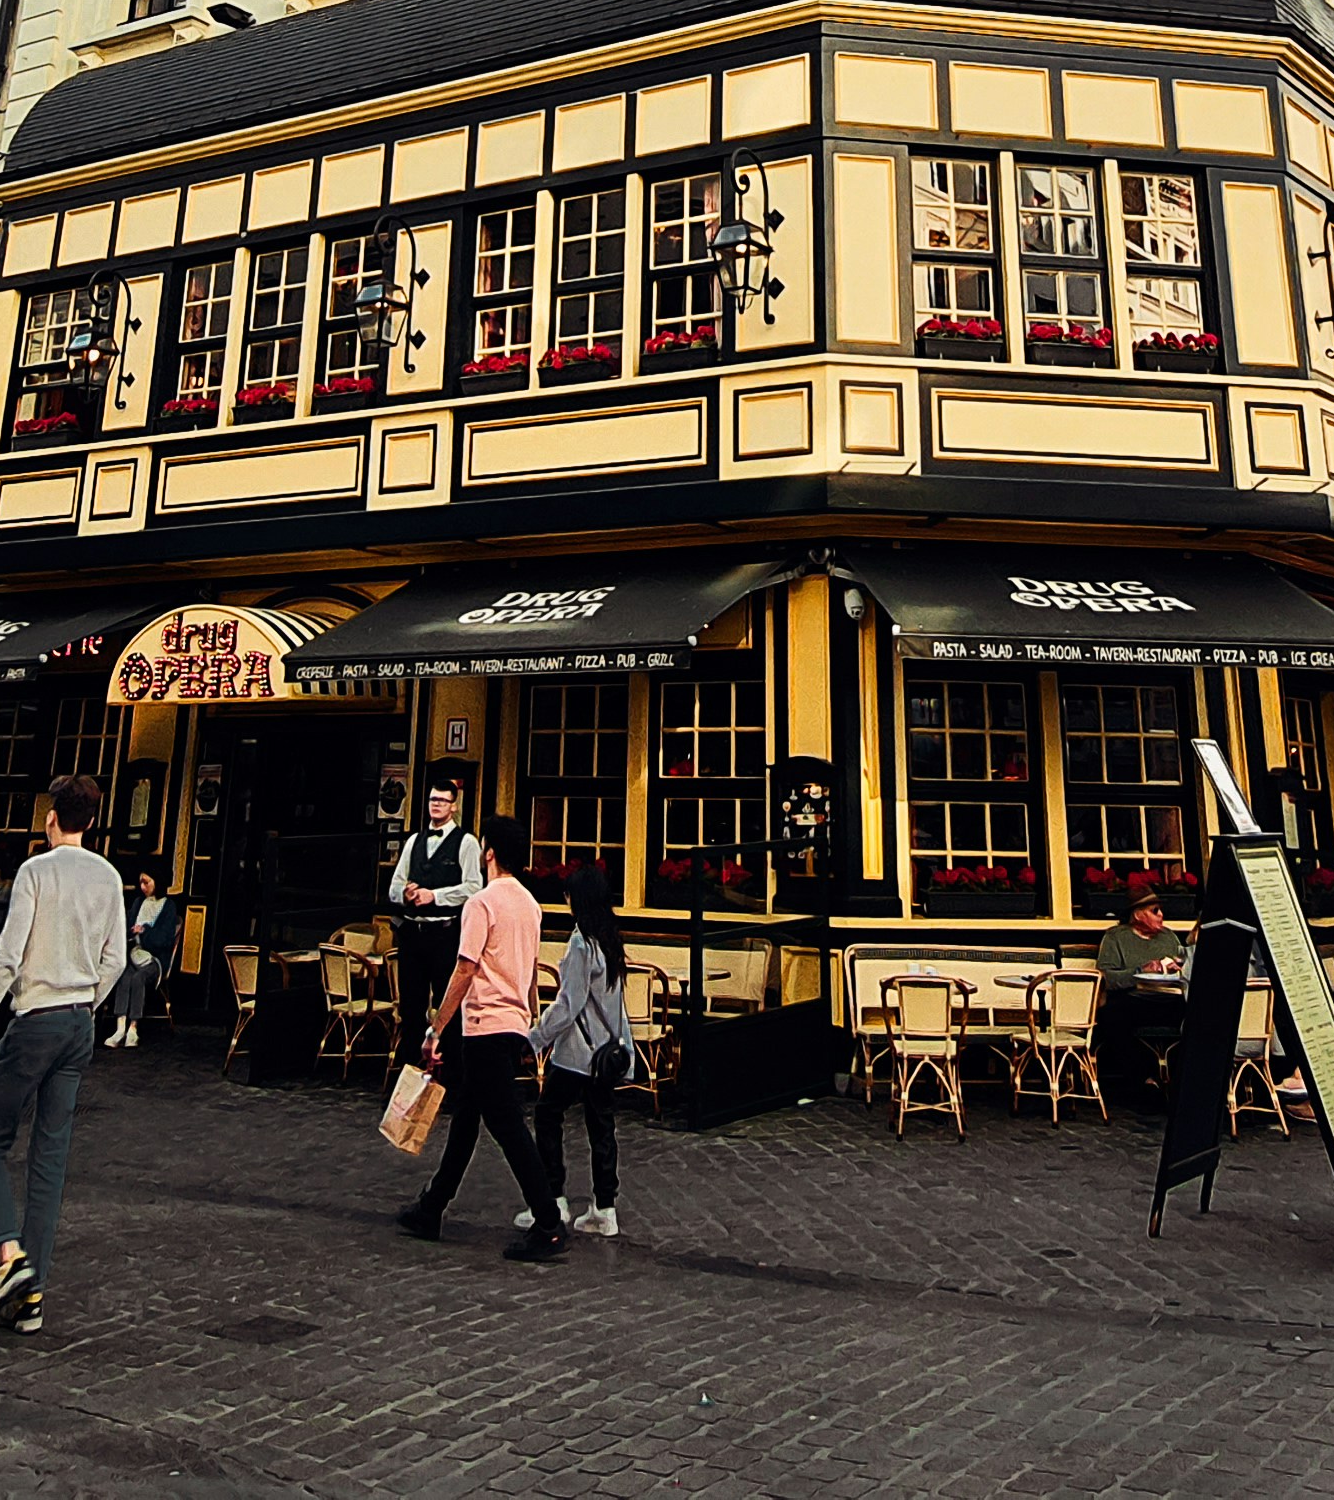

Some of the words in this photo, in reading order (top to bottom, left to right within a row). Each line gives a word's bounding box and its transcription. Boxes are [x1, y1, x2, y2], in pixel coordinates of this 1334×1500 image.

[492, 586, 616, 607] DRUG
[1007, 576, 1155, 596] DRUG
[458, 603, 604, 624] OPERA
[1010, 592, 1197, 613] OPERA
[161, 612, 240, 654] drug
[933, 642, 967, 657] PASTA
[979, 643, 1013, 659] SALAD
[1025, 644, 1082, 660] TEA-ROOM
[1093, 646, 1202, 663] TAVERN-RESTAURANT
[1213, 648, 1247, 664] PIZZA
[1258, 650, 1279, 665] PUB
[1290, 651, 1307, 666] ICE
[117, 650, 276, 700] OPERA
[342, 664, 368, 678] PASTA
[377, 663, 405, 677] SALAD
[470, 656, 565, 673] TAVERN-RESTAURANT
[575, 654, 606, 669] PIZZA
[617, 653, 636, 668] PUB
